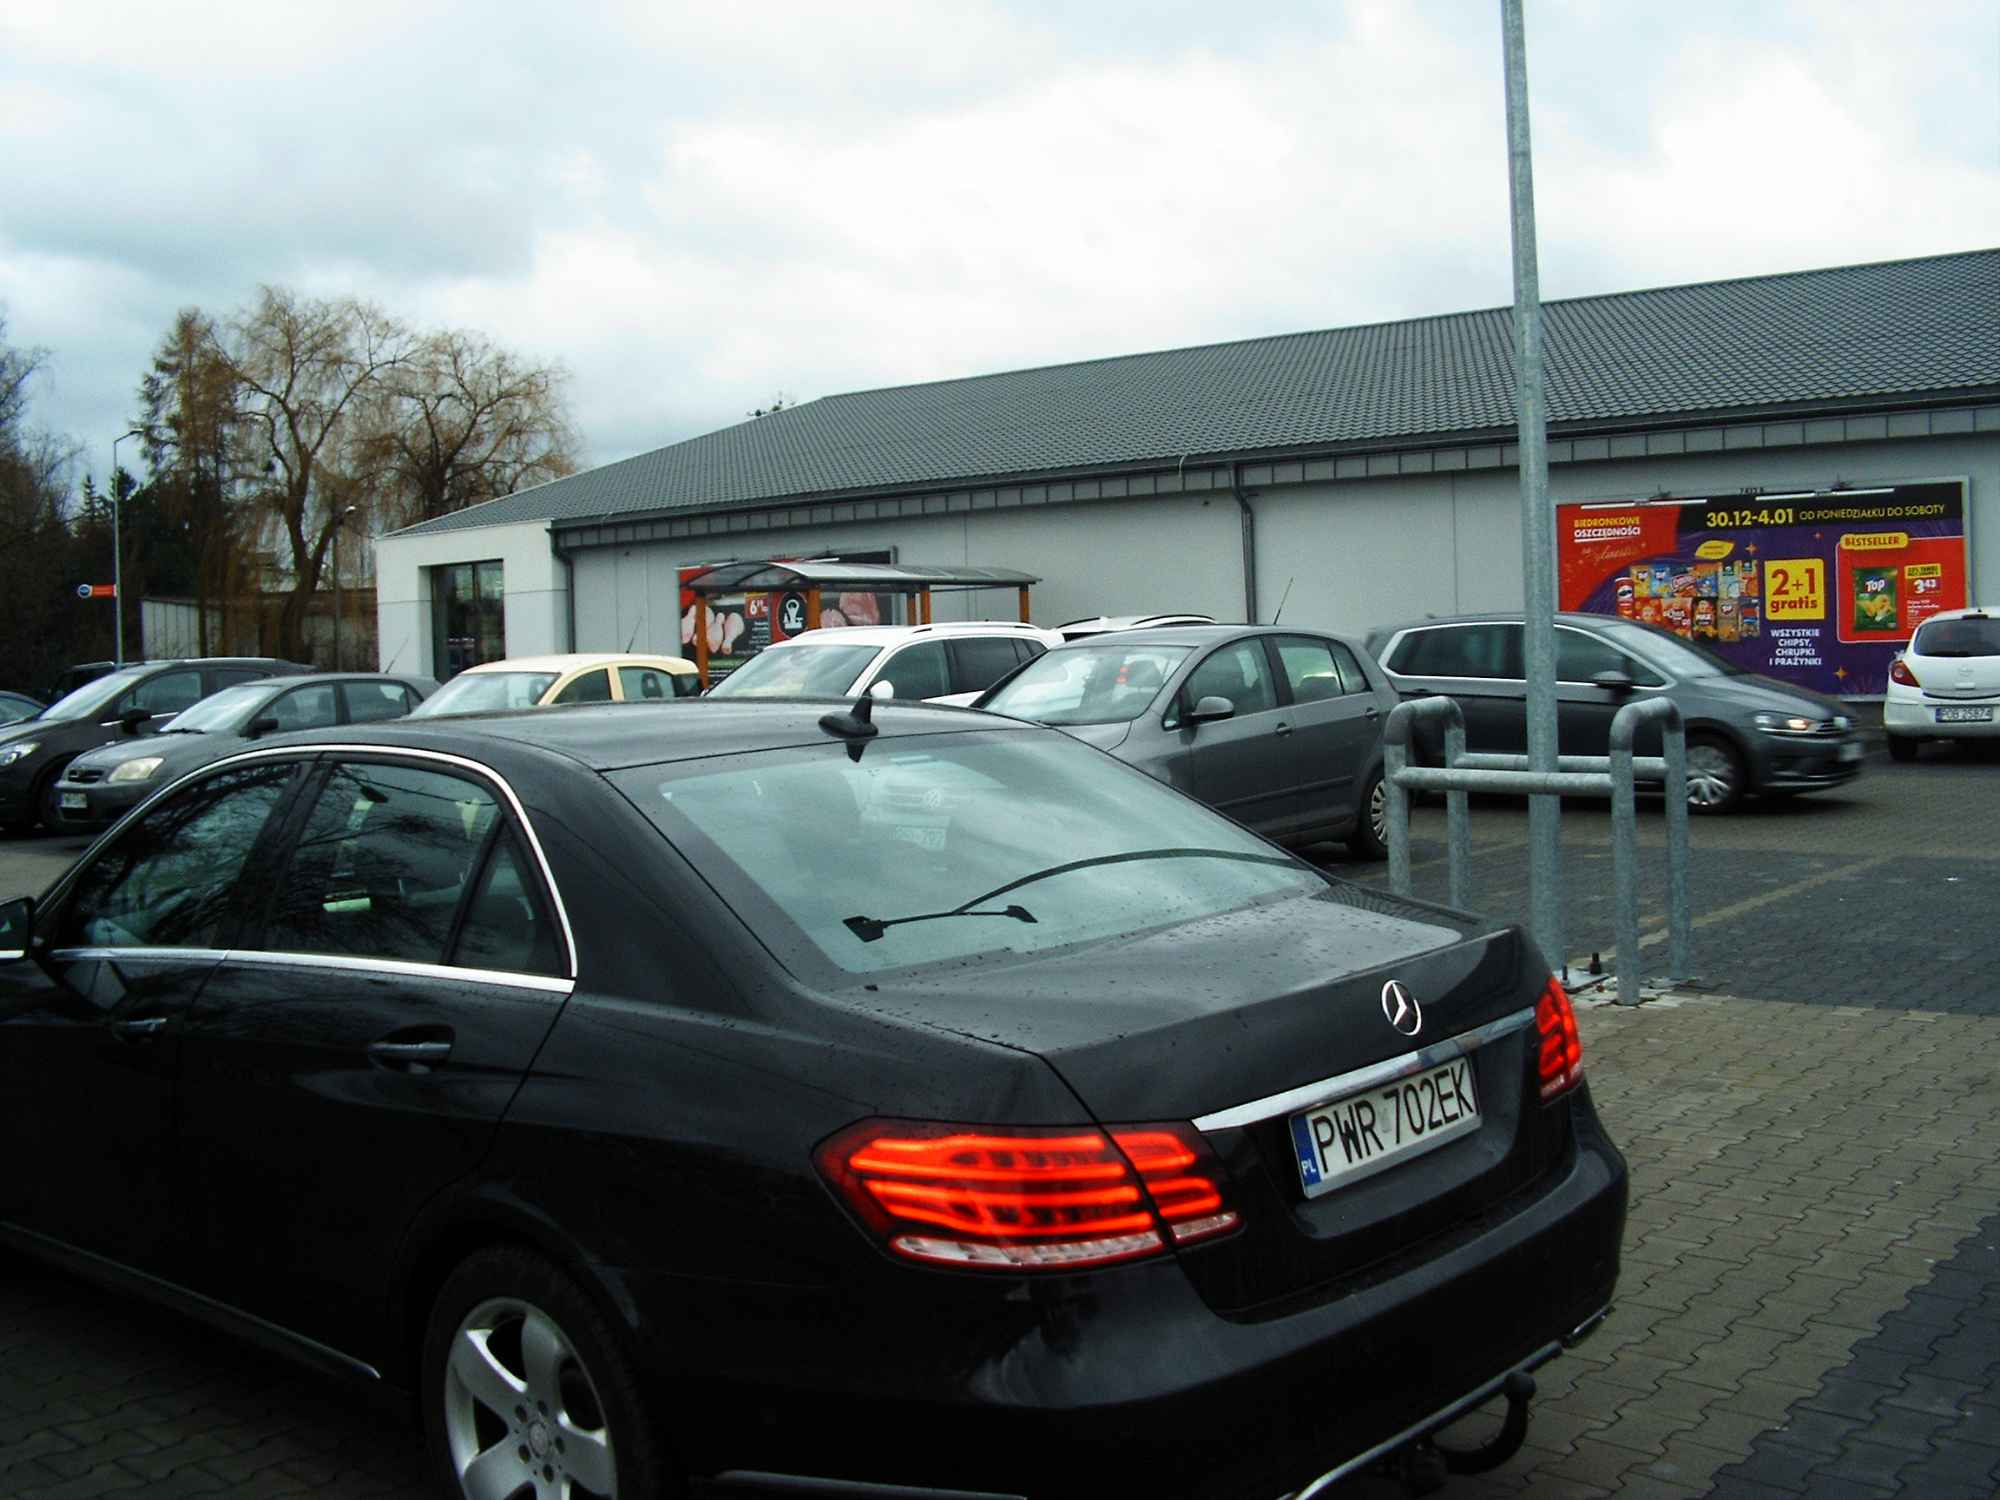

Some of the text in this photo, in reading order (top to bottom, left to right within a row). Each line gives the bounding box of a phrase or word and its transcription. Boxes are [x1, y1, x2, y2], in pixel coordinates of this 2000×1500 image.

[1706, 509, 1793, 527] 30.12-4.01
[1800, 511, 1815, 520] OD
[1888, 506, 1903, 517] DO
[1905, 503, 1945, 516] SOBOTY
[1844, 535, 1900, 547] BESTSELLER
[1771, 568, 1816, 595] 2+1
[1770, 596, 1818, 613] gratis
[1770, 629, 1820, 638] WSZYSTKIE
[1778, 638, 1812, 647] CHIPSY,
[1776, 648, 1815, 656] CHRUPKI
[1312, 1063, 1474, 1173] PWR 702EK
[1301, 1160, 1316, 1176] PL
